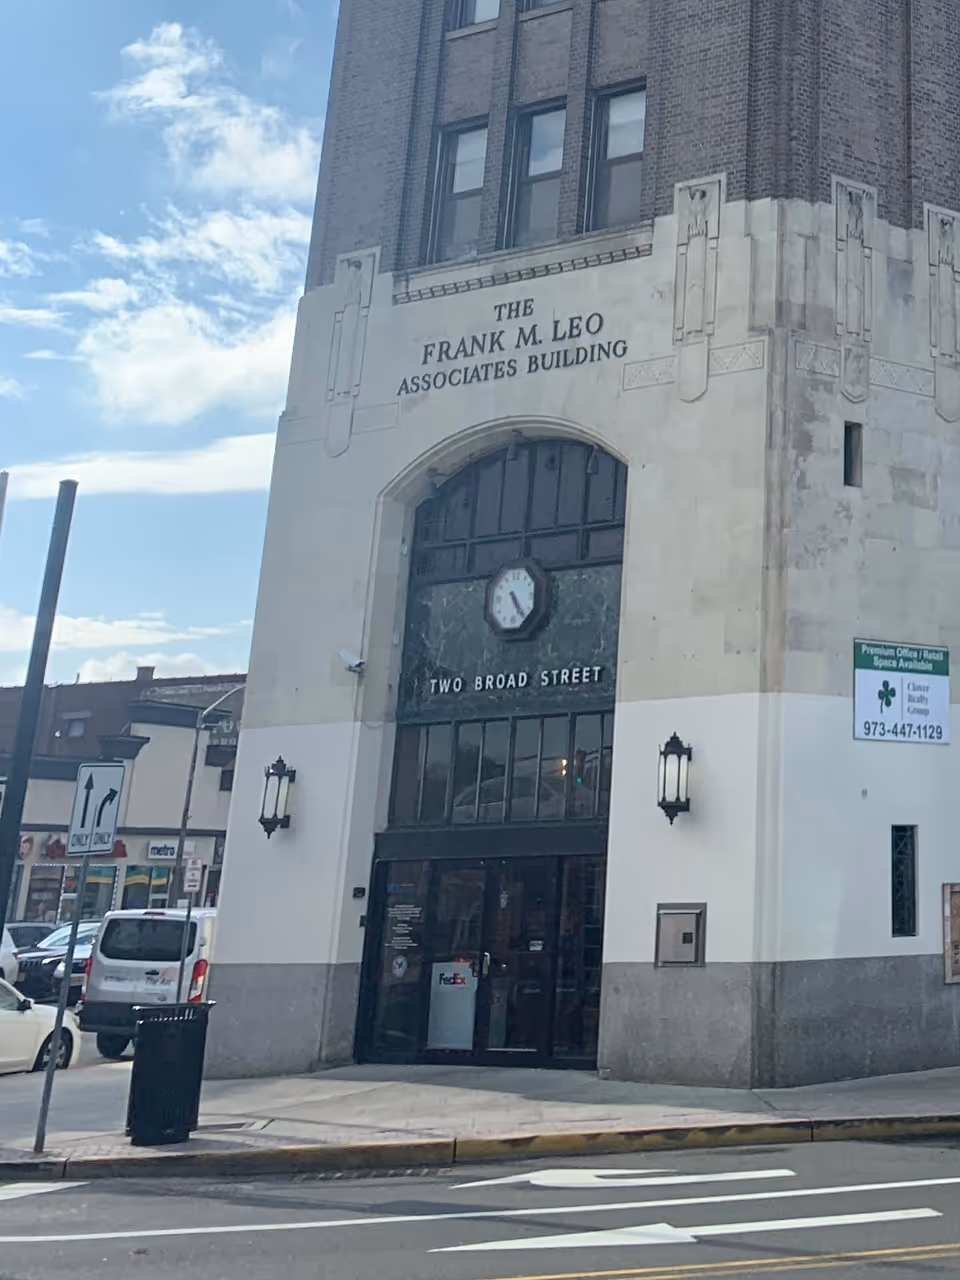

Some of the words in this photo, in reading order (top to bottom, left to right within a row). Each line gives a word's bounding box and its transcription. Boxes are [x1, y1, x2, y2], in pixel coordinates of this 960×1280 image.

[494, 298, 534, 321] THE
[422, 331, 505, 365] FRANK
[515, 324, 543, 349] M.
[552, 312, 604, 342] LEO
[397, 359, 517, 396] ASSOCIATES
[527, 340, 628, 374] BUILDING
[862, 644, 894, 655] Premium
[896, 648, 918, 658] Office
[923, 651, 944, 661] Retail
[873, 656, 897, 668] Space
[899, 659, 933, 671] Available
[430, 679, 462, 694] TWO
[475, 673, 528, 690] BROAD
[541, 667, 601, 686] STREET
[864, 720, 943, 740] 973-447-1129
[72, 833, 90, 846] ONLY
[94, 832, 112, 845] ONLY
[150, 844, 175, 856] metro
[439, 973, 466, 984] FedEx
